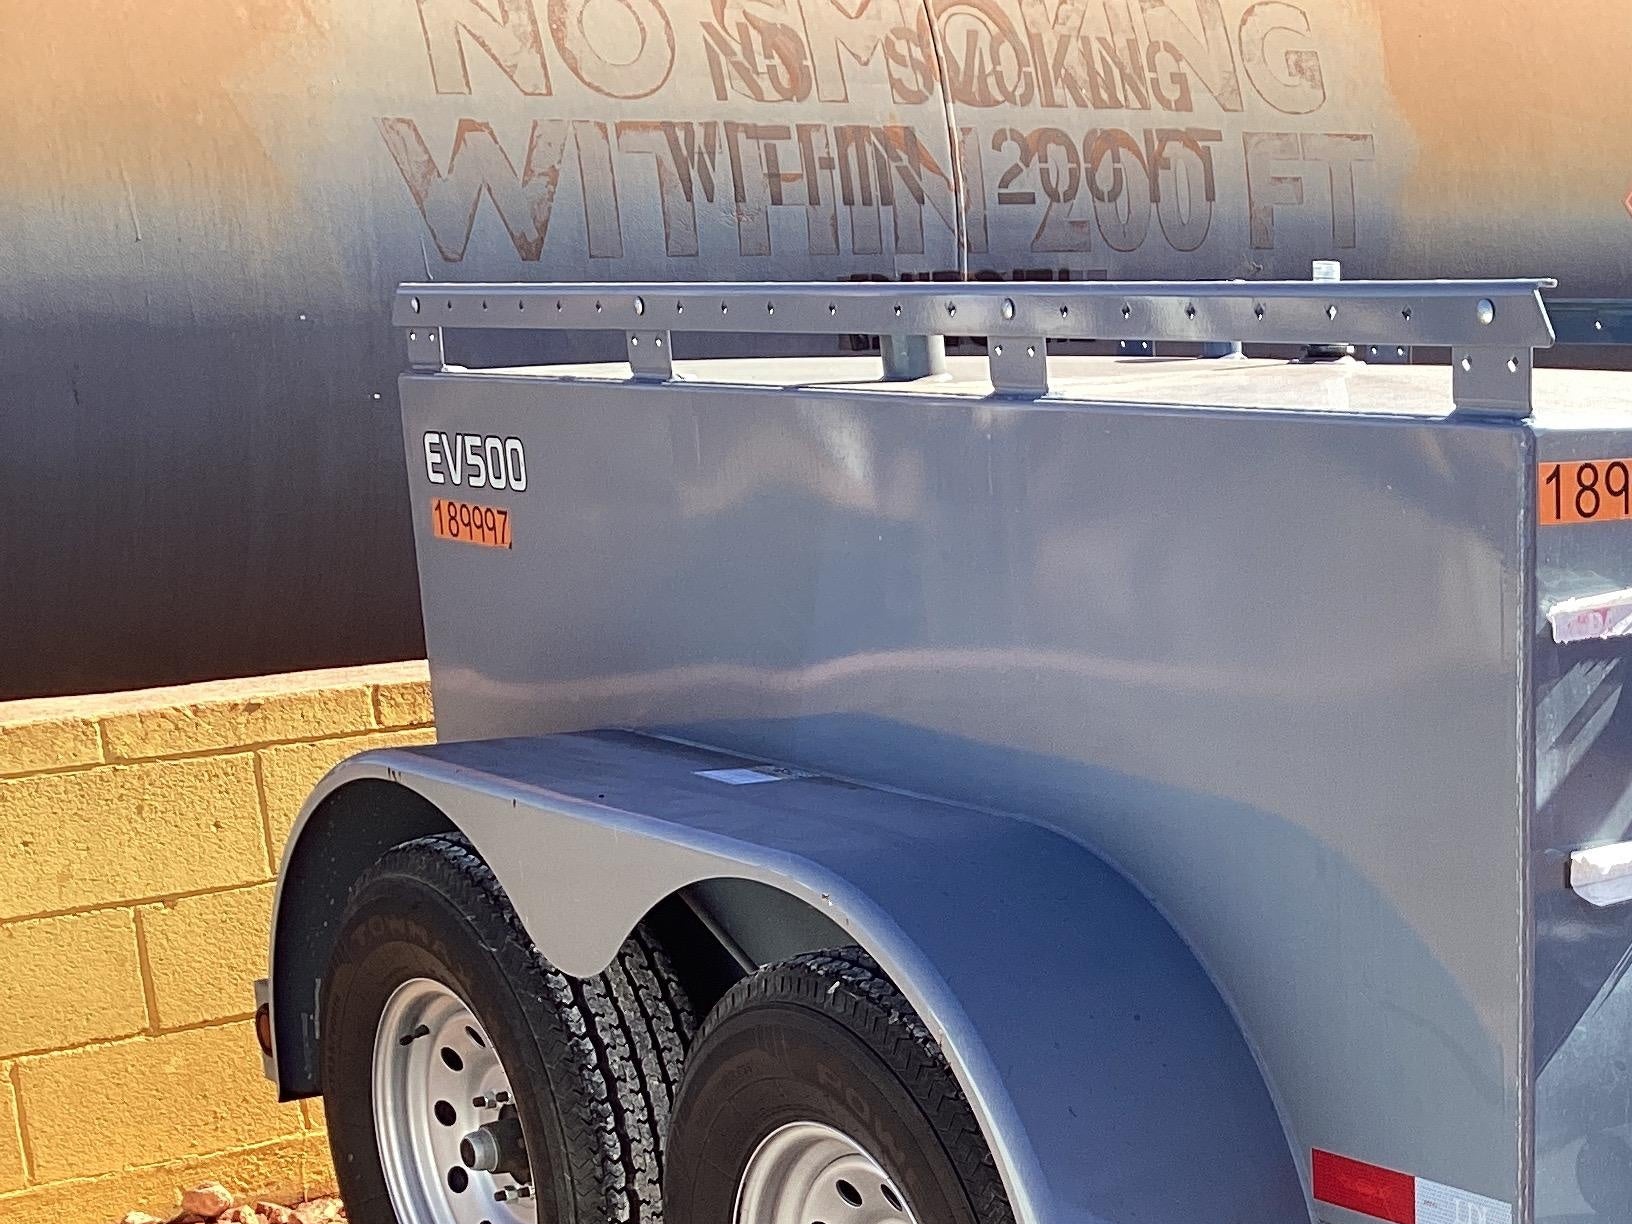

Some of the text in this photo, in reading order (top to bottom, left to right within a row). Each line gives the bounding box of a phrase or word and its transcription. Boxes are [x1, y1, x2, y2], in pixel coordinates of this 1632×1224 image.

[416, 0, 676, 99] NO
[375, 116, 989, 262] WITHIN
[1242, 131, 1375, 251] FT
[423, 431, 528, 492] EV500
[434, 499, 508, 545] 189997
